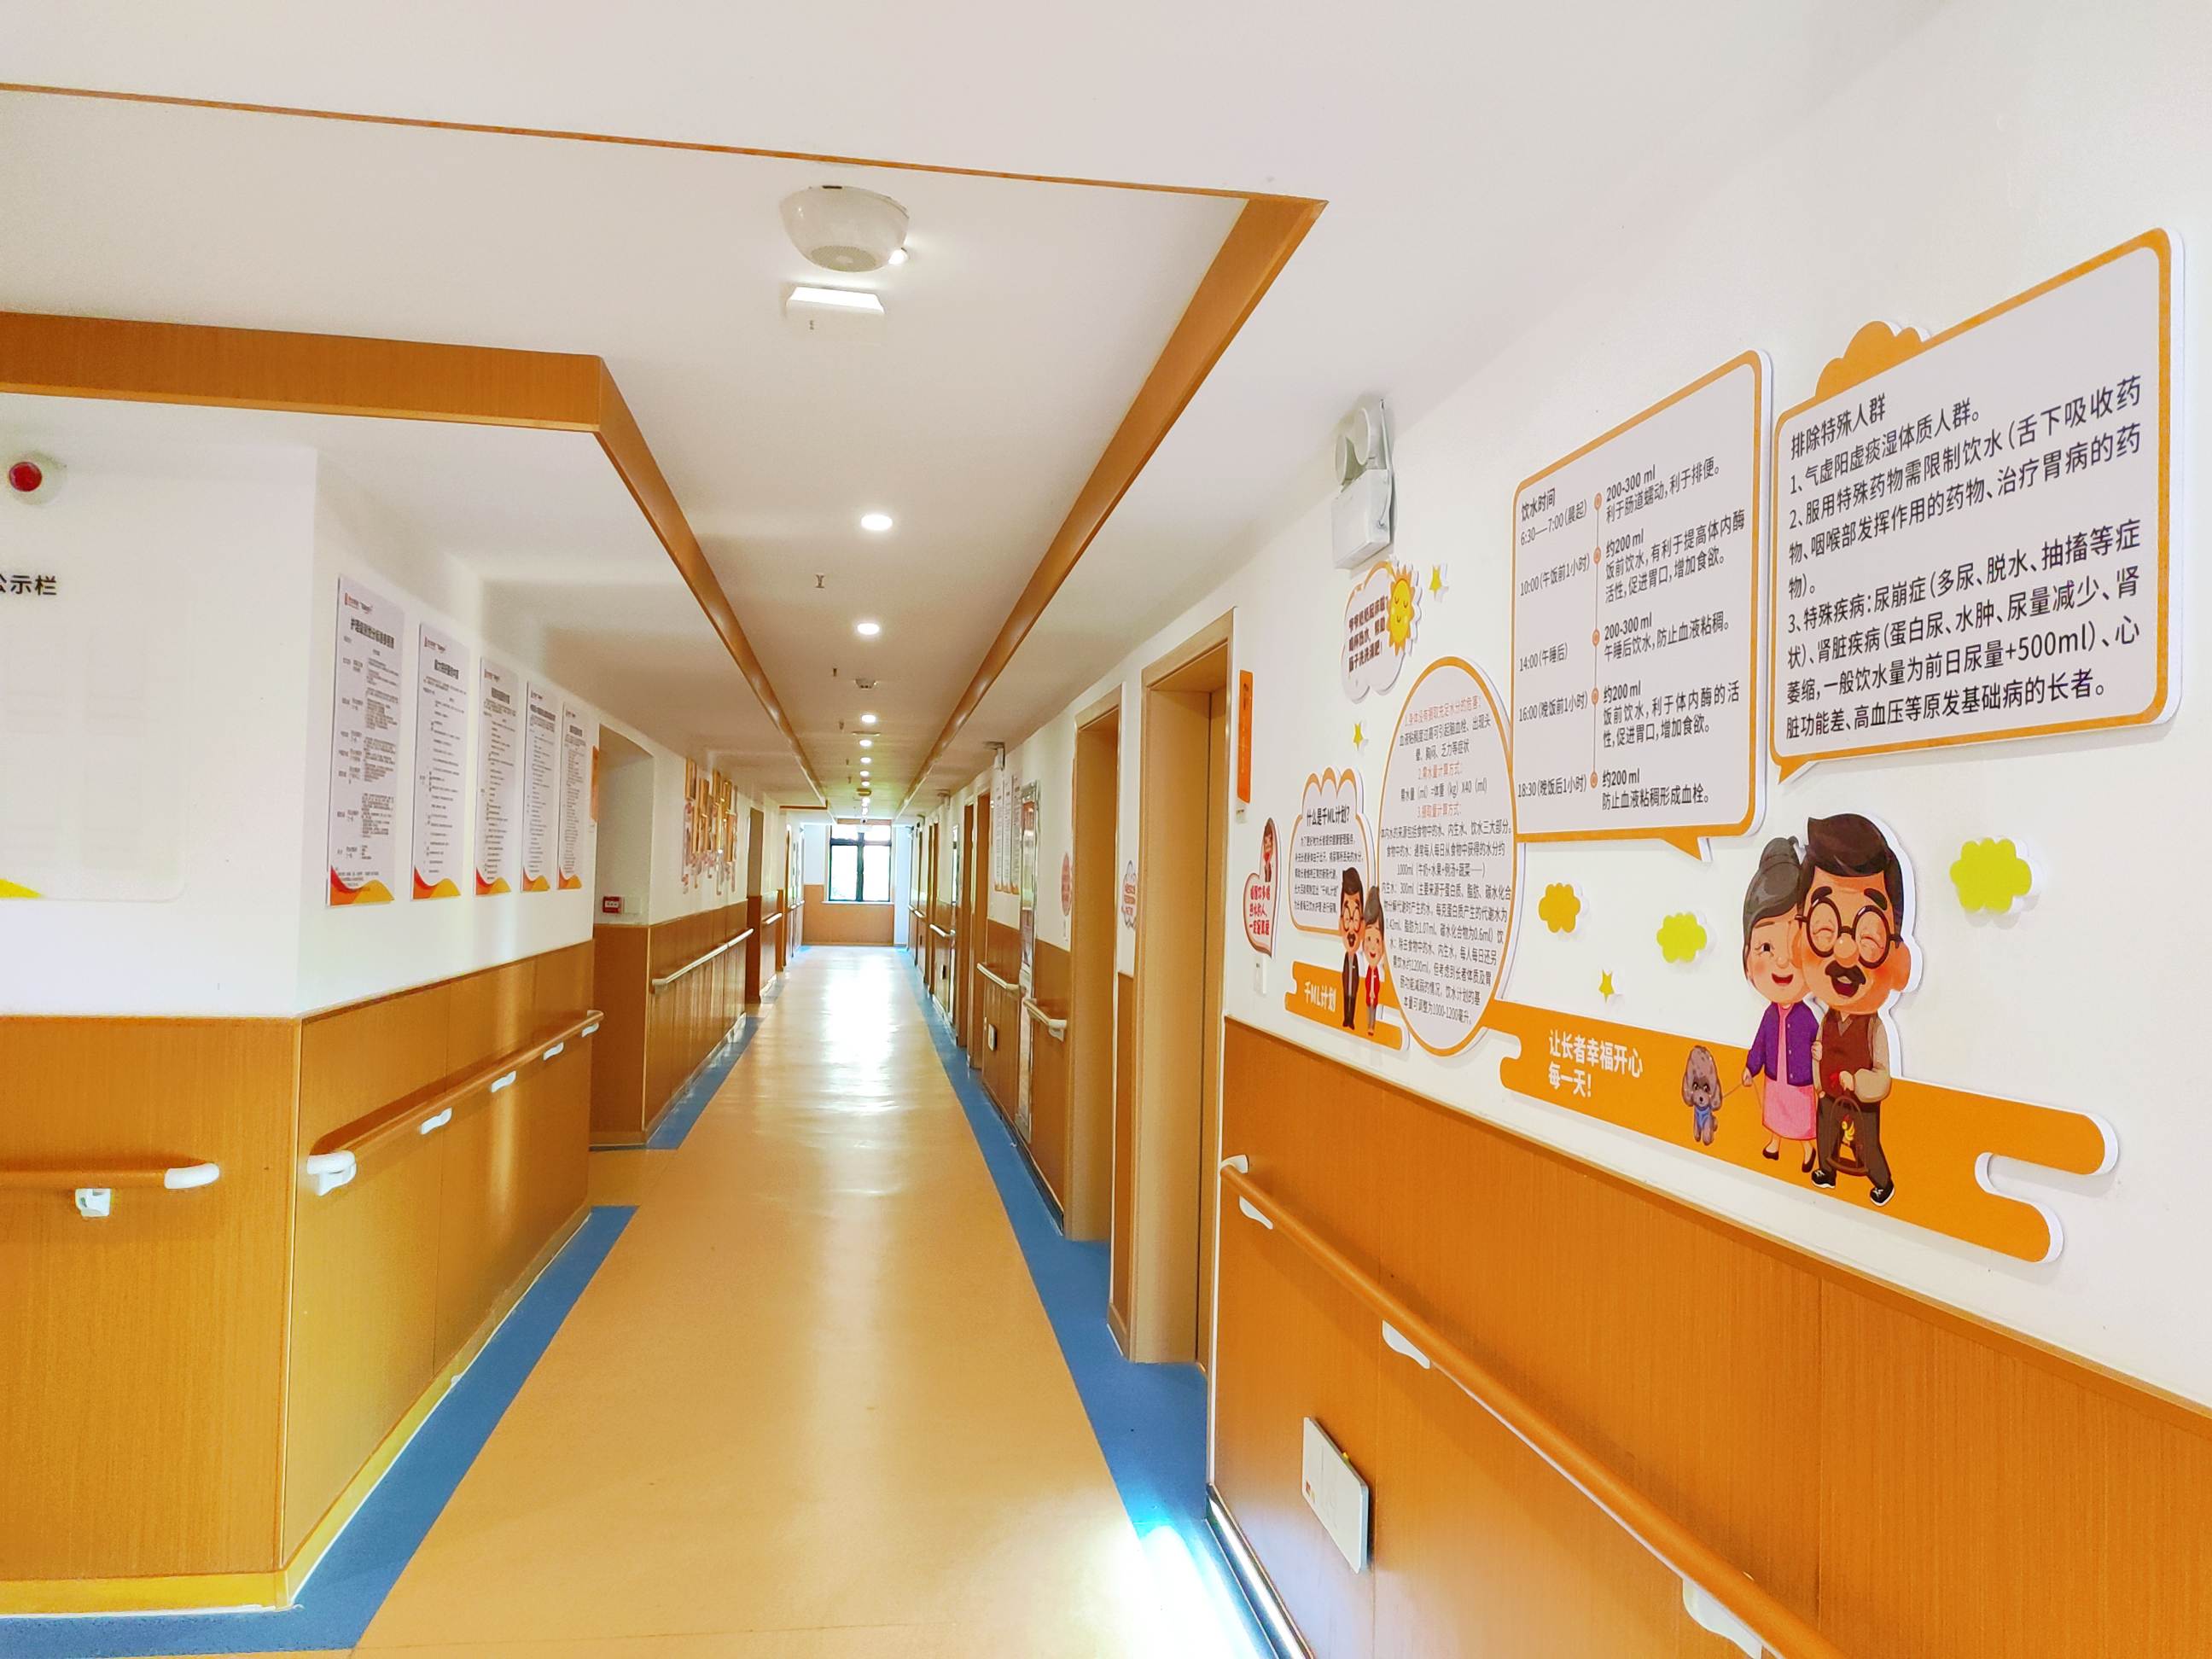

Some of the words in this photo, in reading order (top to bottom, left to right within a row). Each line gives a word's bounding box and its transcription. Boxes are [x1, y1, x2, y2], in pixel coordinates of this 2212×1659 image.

[1790, 398, 1979, 495] 1、气虚阳虚痰湿体质人群。
[1791, 393, 1885, 460] 排除特殊人群
[1789, 375, 2141, 530] 2、服用特殊药物需限制饮水（舌下吸收药
[1522, 487, 1556, 522] 饮水时间
[1605, 457, 1720, 523] 利于肠道蠕动，利于排便。
[1606, 472, 1641, 503] 200-300
[1789, 422, 2140, 565] 物、咽喉部发挥作用的药物、治疗胃病的药
[1605, 509, 1745, 580] 饭前饮水，有利于提高体内酶
[1605, 545, 1725, 603] 活性，促进胃口，增加食欲。
[1604, 616, 1639, 640] 200-300
[1604, 611, 1729, 662] 午睡后饮水，防止血液粘稠。
[1603, 679, 1740, 725] 饭前饮水，利于体内酶的活
[1786, 668, 2104, 739] 脏功能差、高血压等原发基础病的长者。
[1603, 713, 1710, 748] 性，促进胃口，增加食欲。
[1602, 783, 1709, 811] 防止血液粘稠形成血栓。
[1304, 981, 1337, 1013] 千ML计划
[1549, 1029, 1644, 1078] 让长者幸福开心
[1548, 1061, 1592, 1098] 每一天！
